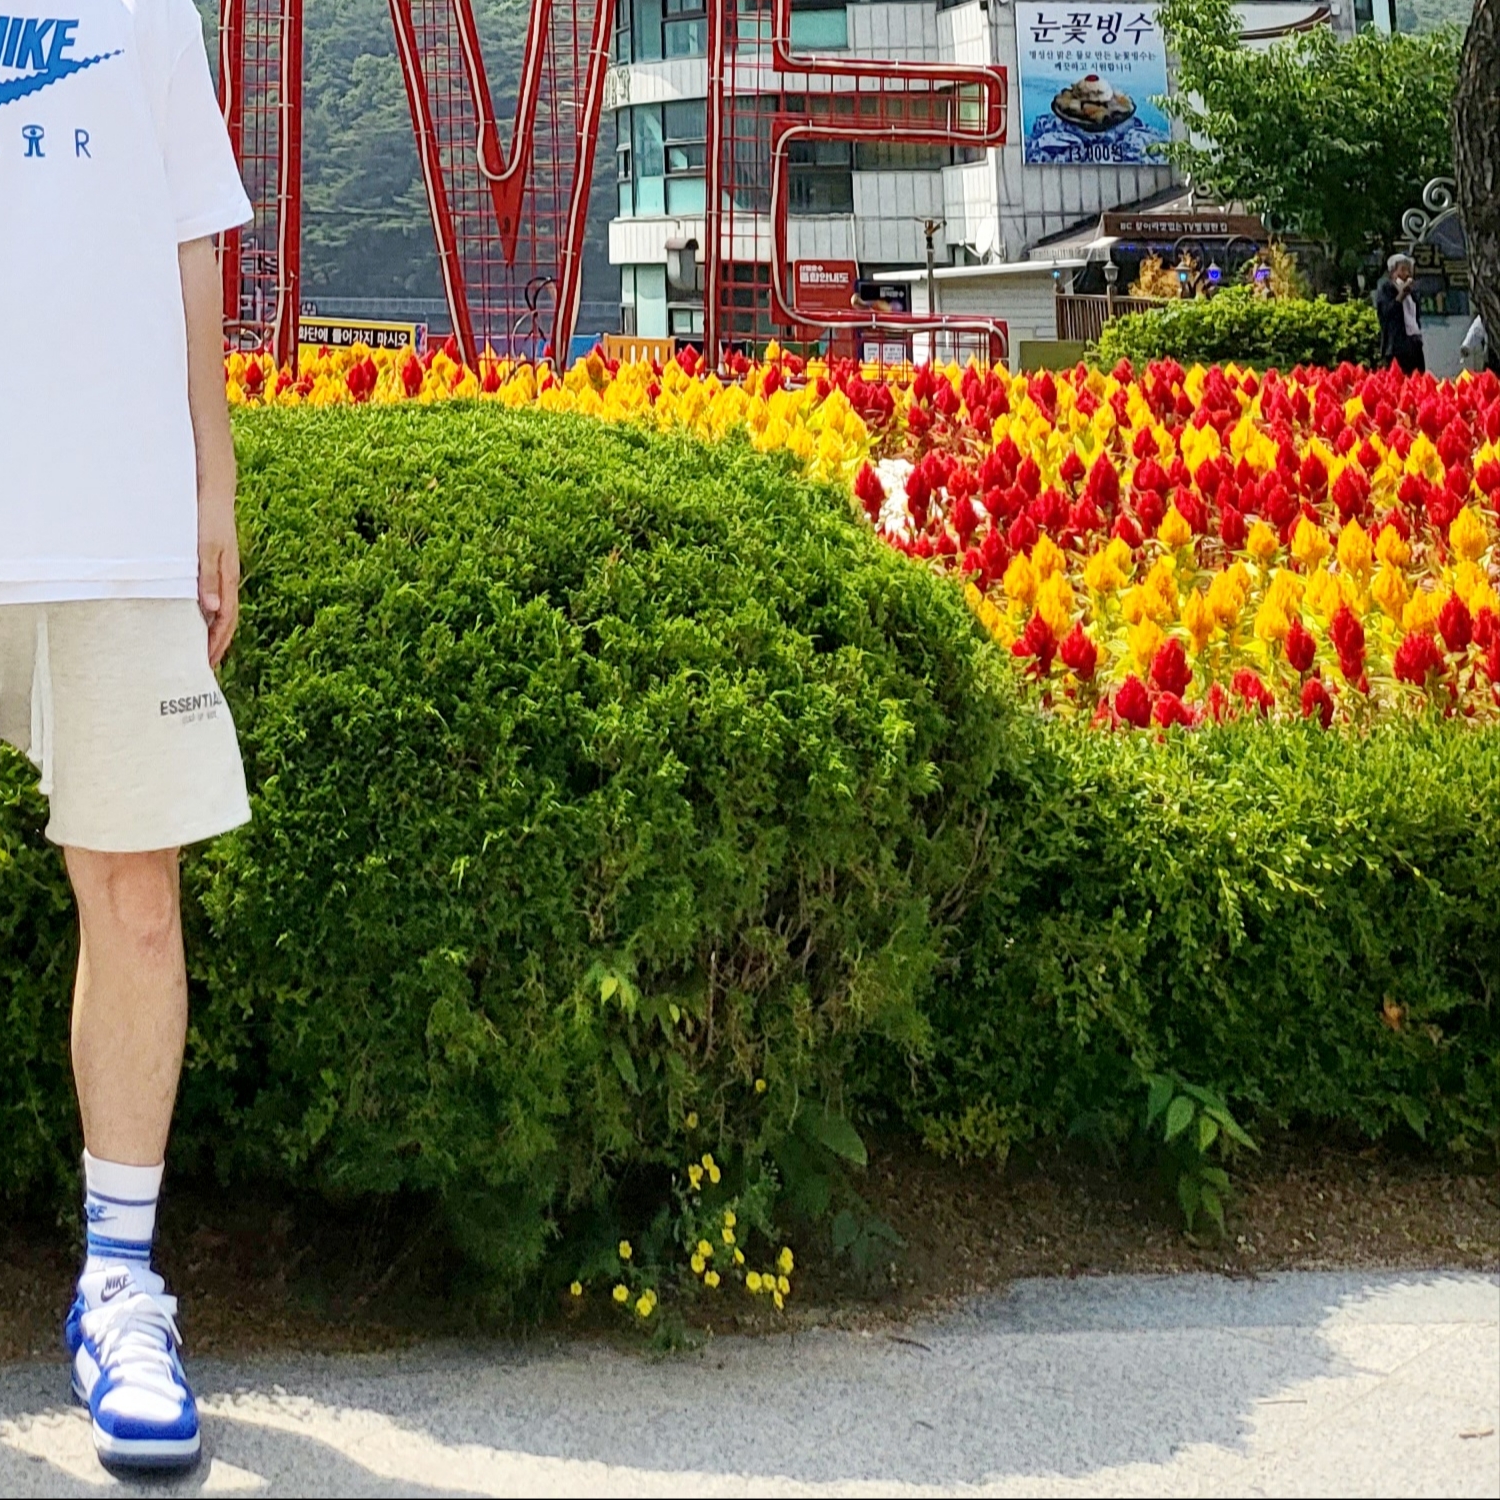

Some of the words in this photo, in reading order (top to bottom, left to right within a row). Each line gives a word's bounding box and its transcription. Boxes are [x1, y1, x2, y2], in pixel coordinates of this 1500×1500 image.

[1030, 11, 1155, 46] 눈꽃빙수
[376, 331, 408, 347] 마시오
[105, 1273, 130, 1292] NIKE
